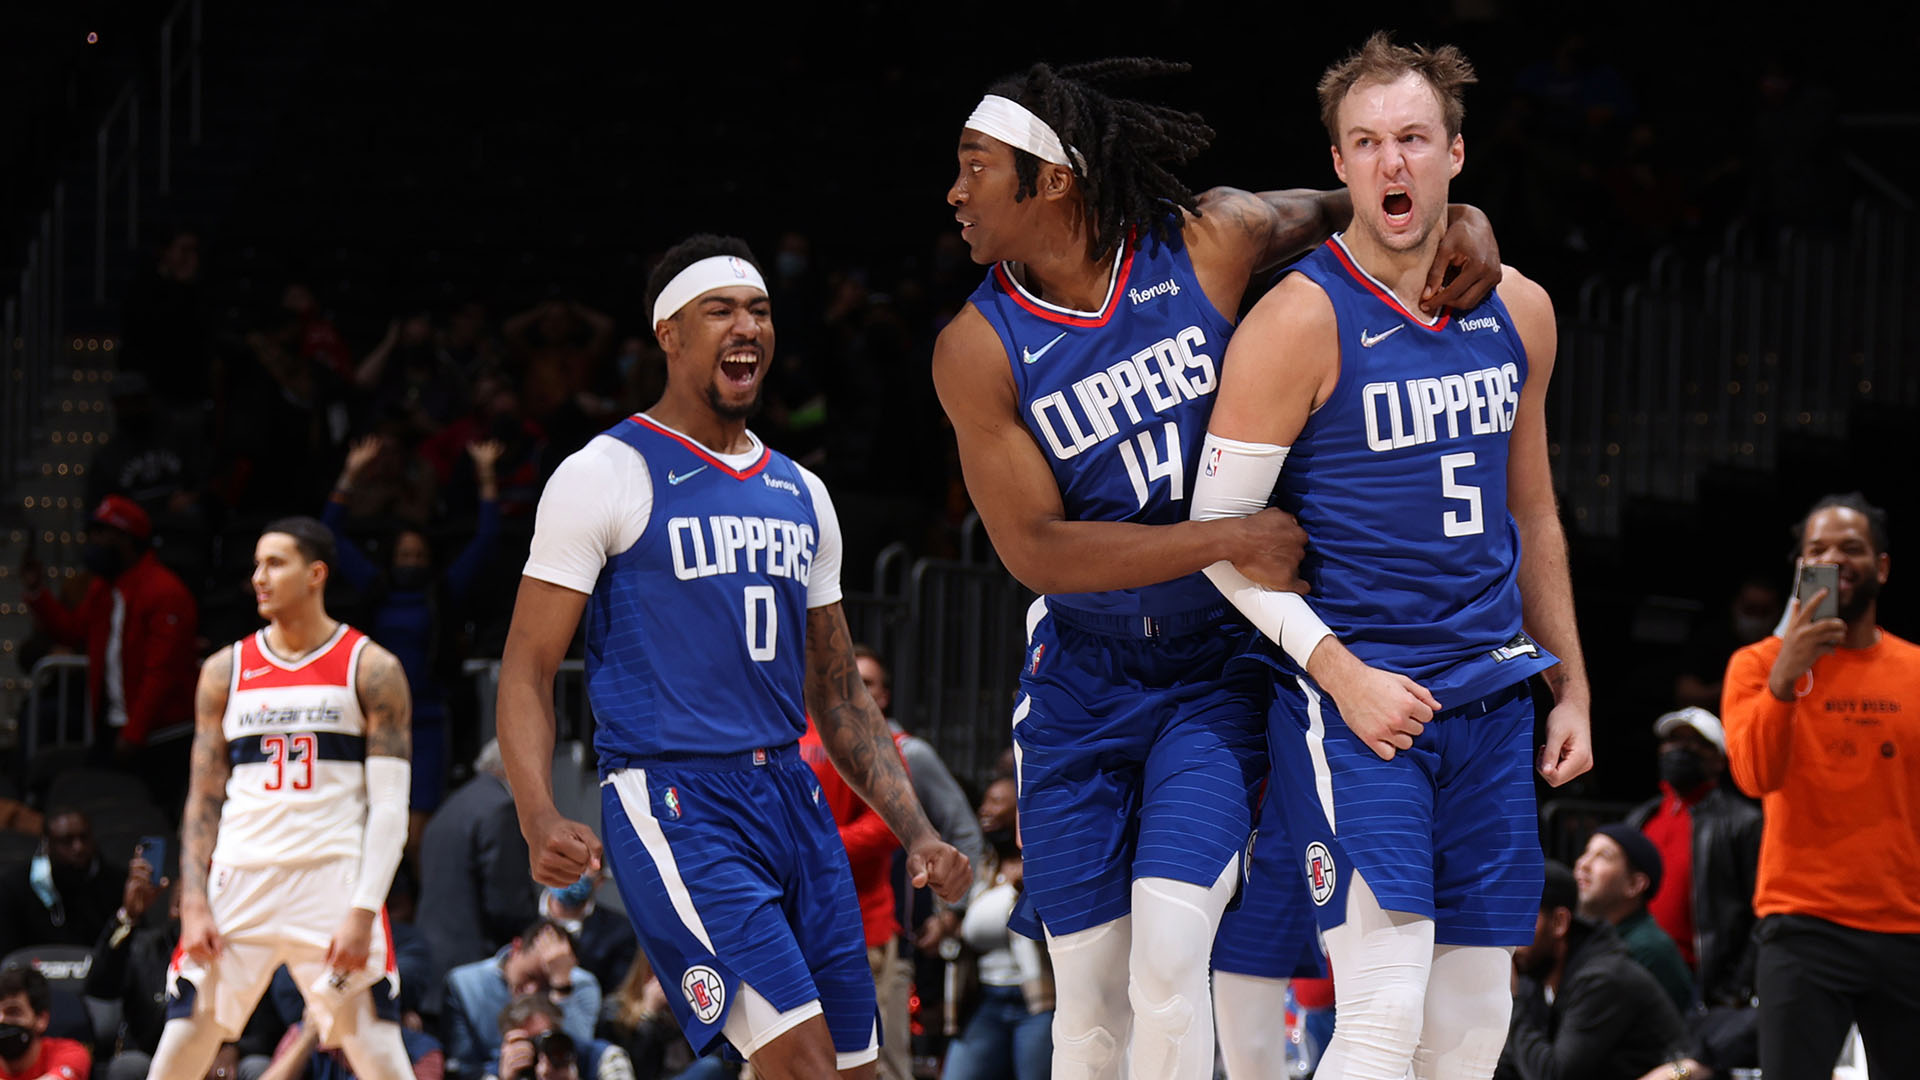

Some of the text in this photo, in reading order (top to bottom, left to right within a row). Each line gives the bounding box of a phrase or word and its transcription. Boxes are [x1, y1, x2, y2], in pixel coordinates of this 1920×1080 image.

[1128, 278, 1181, 305] honey
[1458, 316, 1501, 334] honey
[1030, 326, 1218, 460] CLIPPERS
[1362, 362, 1519, 452] CLIPPERS
[762, 472, 800, 496] honey
[1117, 422, 1184, 510] 14
[1440, 452, 1484, 538] 5
[668, 515, 815, 588] CLIPPERS
[744, 586, 777, 662] 0
[240, 701, 339, 725] wizards
[261, 732, 318, 792] 33
